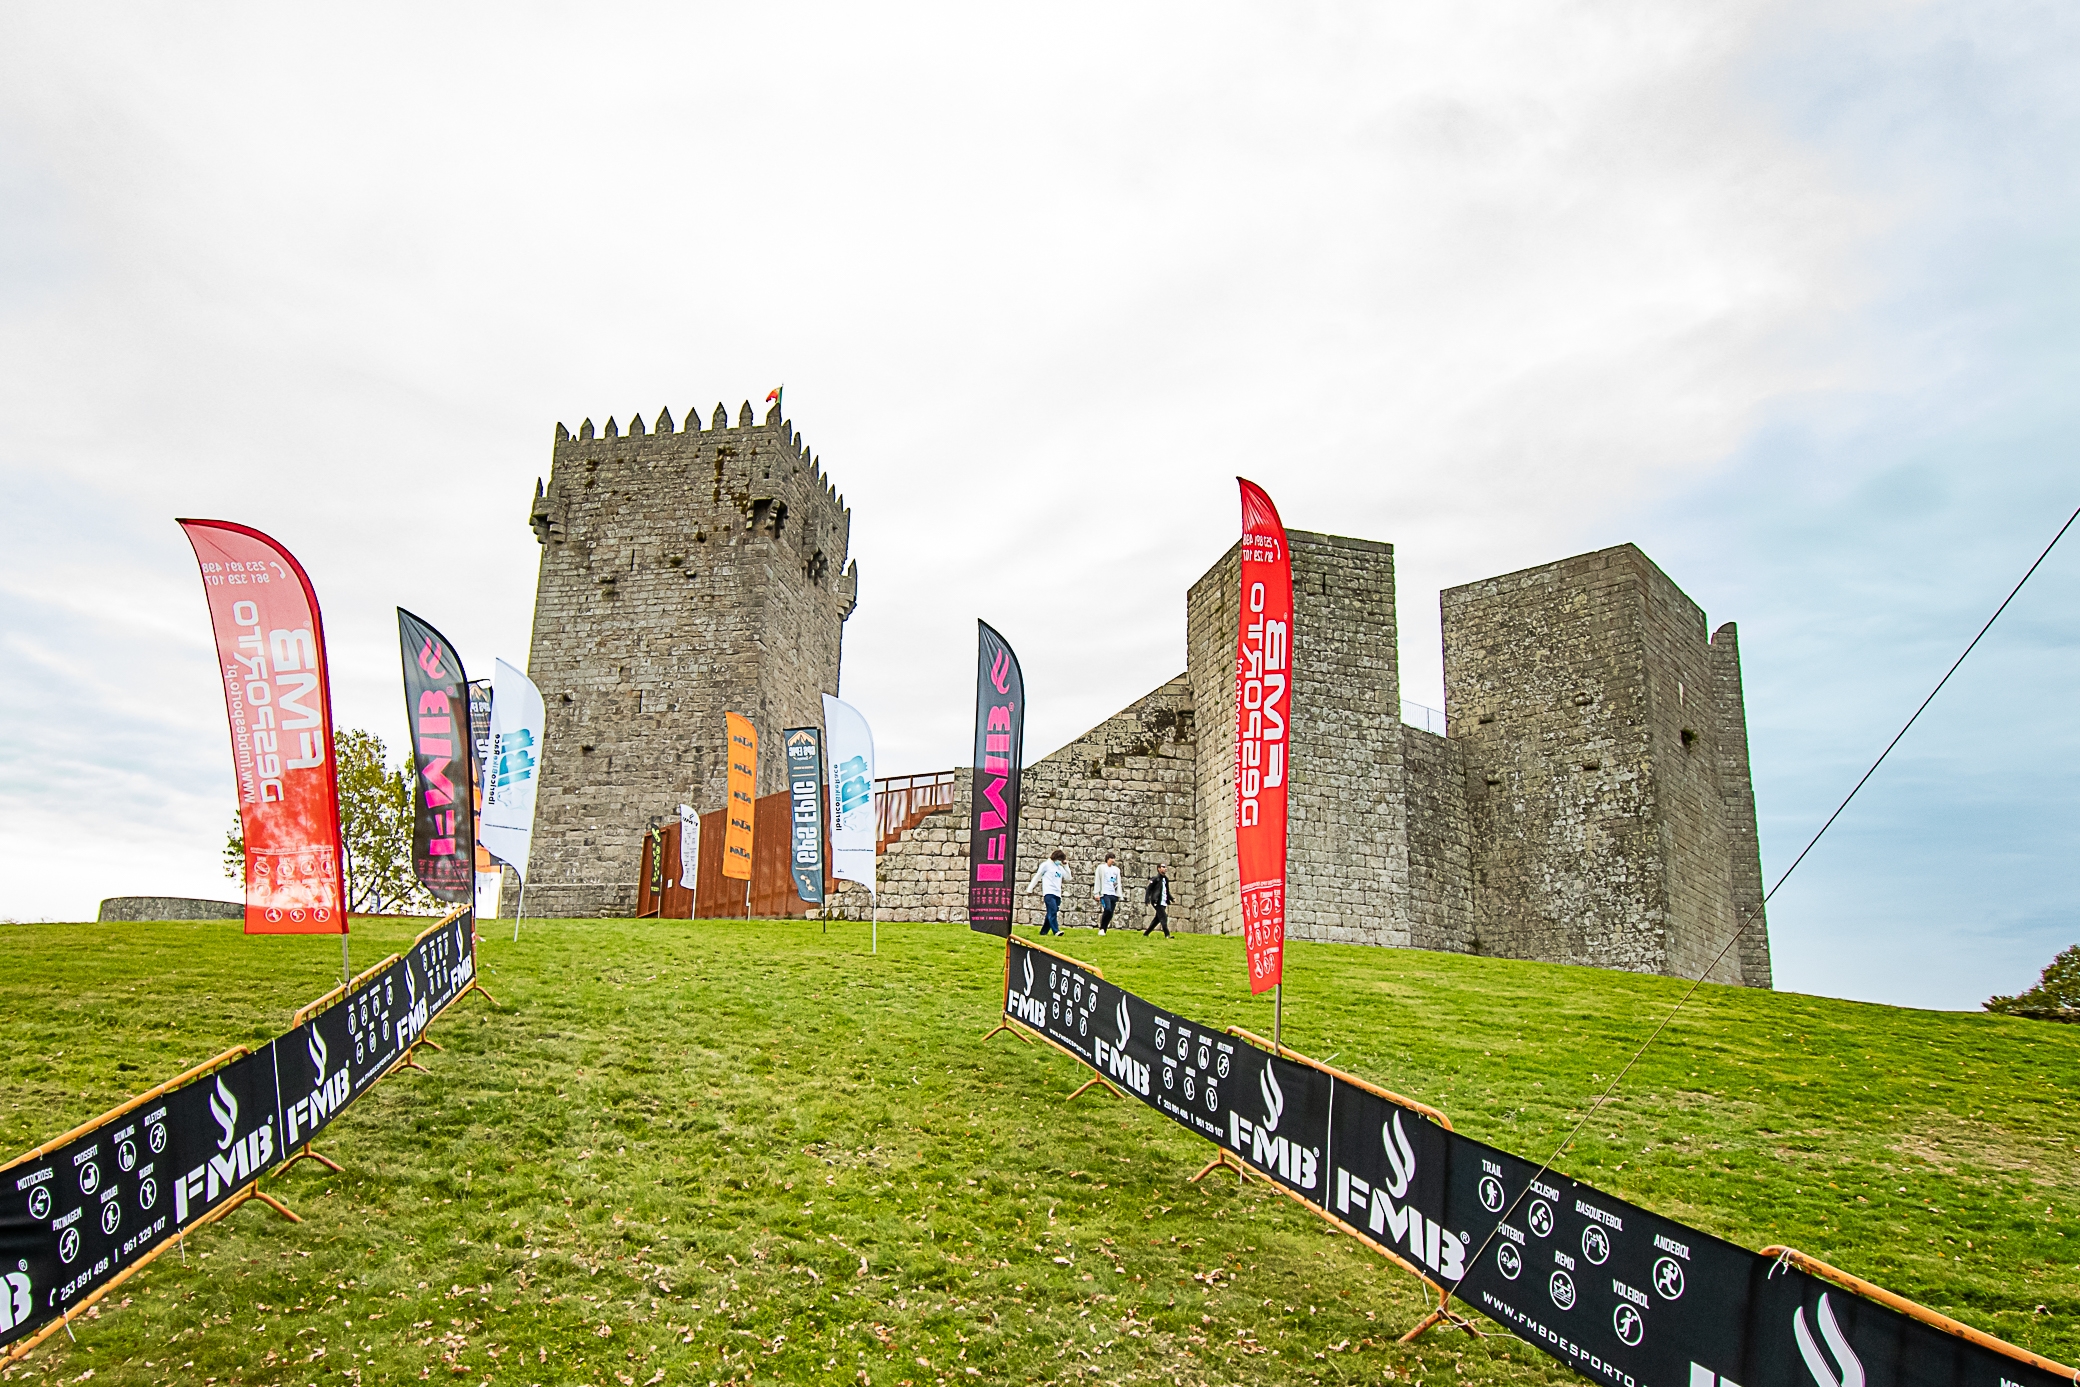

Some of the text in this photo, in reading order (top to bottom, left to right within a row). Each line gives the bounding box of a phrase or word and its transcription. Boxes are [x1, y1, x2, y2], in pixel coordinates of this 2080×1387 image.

[74, 1144, 98, 1166] CROSSFIT
[17, 1168, 53, 1190] MOTOCROSS
[1482, 1159, 1502, 1178] TRAIL
[1530, 1179, 1559, 1202] CICLISMO
[52, 1206, 82, 1231] PATINAGEM
[1576, 1200, 1623, 1232] BASQUETEBOL
[1498, 1222, 1525, 1246] FUTEBOL
[61, 1281, 76, 1300] 253
[77, 1268, 91, 1288] 891
[94, 1257, 108, 1276] 498
[123, 1236, 136, 1254] 961
[138, 1226, 152, 1244] 329
[153, 1216, 166, 1233] 107
[1654, 1234, 1690, 1260] ANDEBOL
[1555, 1250, 1574, 1271] REMO
[1613, 1279, 1649, 1309] VOLEIBOL
